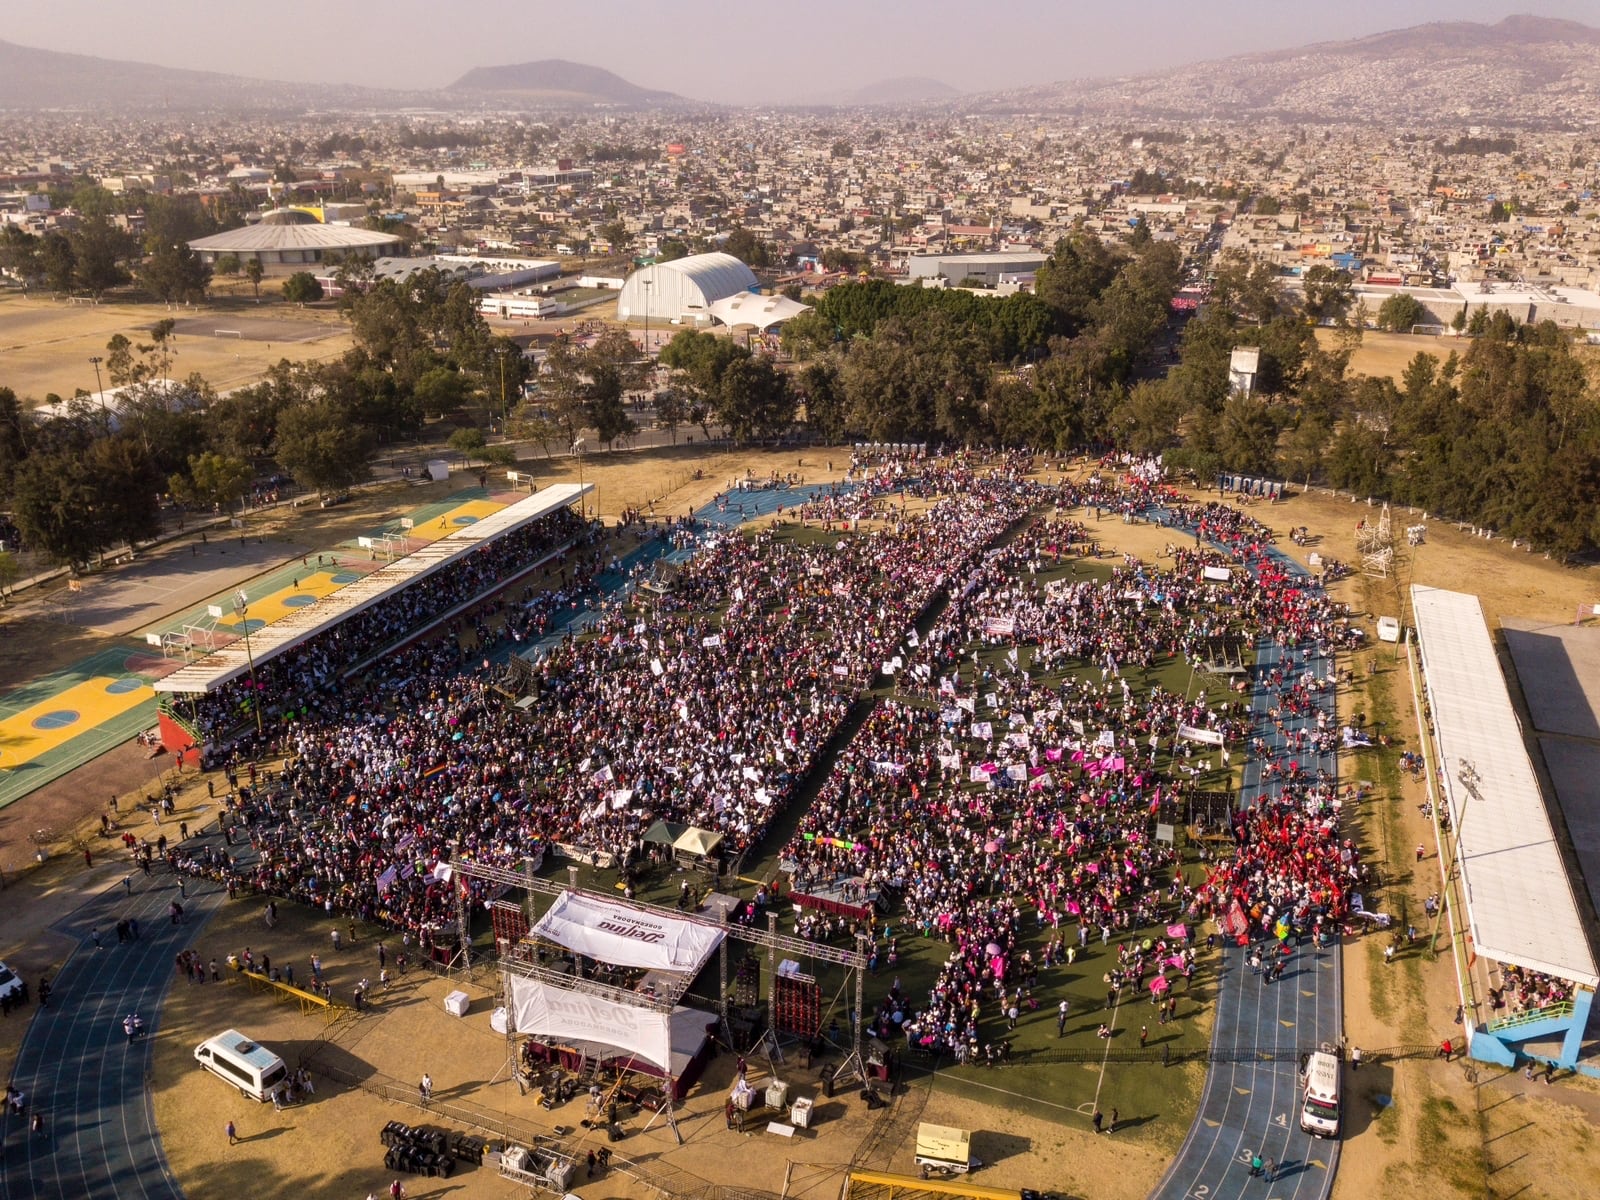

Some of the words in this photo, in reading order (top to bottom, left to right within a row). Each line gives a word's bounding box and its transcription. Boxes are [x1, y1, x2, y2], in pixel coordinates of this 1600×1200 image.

[613, 914, 662, 929] GOBERNADORA
[597, 921, 665, 943] Delfina
[1275, 1113, 1287, 1126] 4
[1239, 1149, 1253, 1162] 3
[1194, 1185, 1209, 1200] 2
